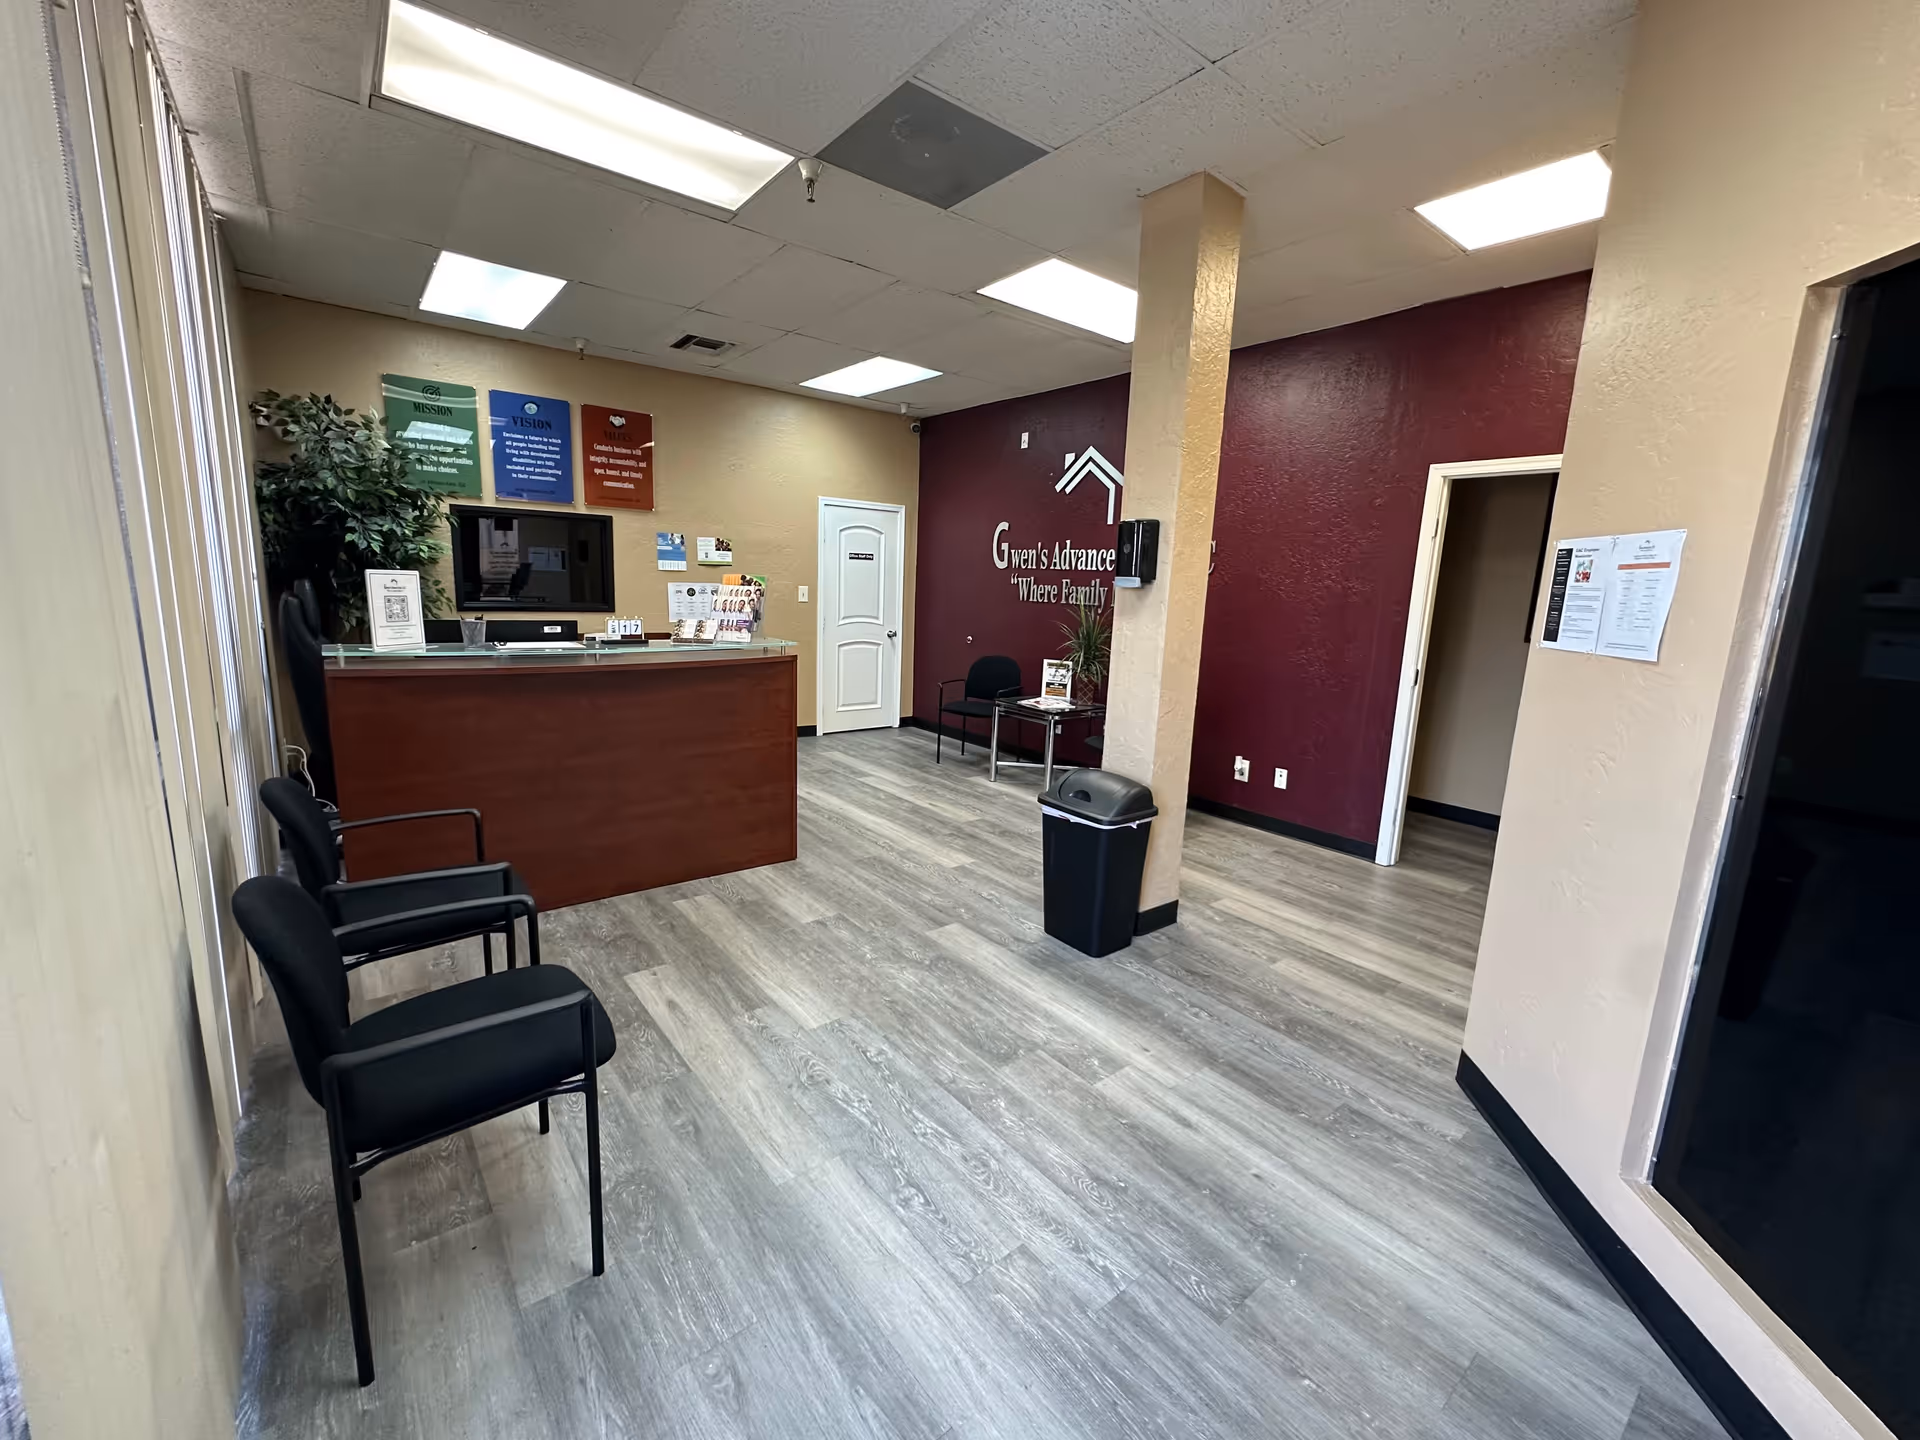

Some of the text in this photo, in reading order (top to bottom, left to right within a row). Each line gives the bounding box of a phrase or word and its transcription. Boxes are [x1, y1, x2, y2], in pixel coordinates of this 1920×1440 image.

[413, 402, 452, 416] MISSION
[512, 416, 552, 430] VISION
[992, 521, 1048, 570] Gwen's
[1060, 578, 1108, 612] Family
[634, 624, 639, 633] 7
